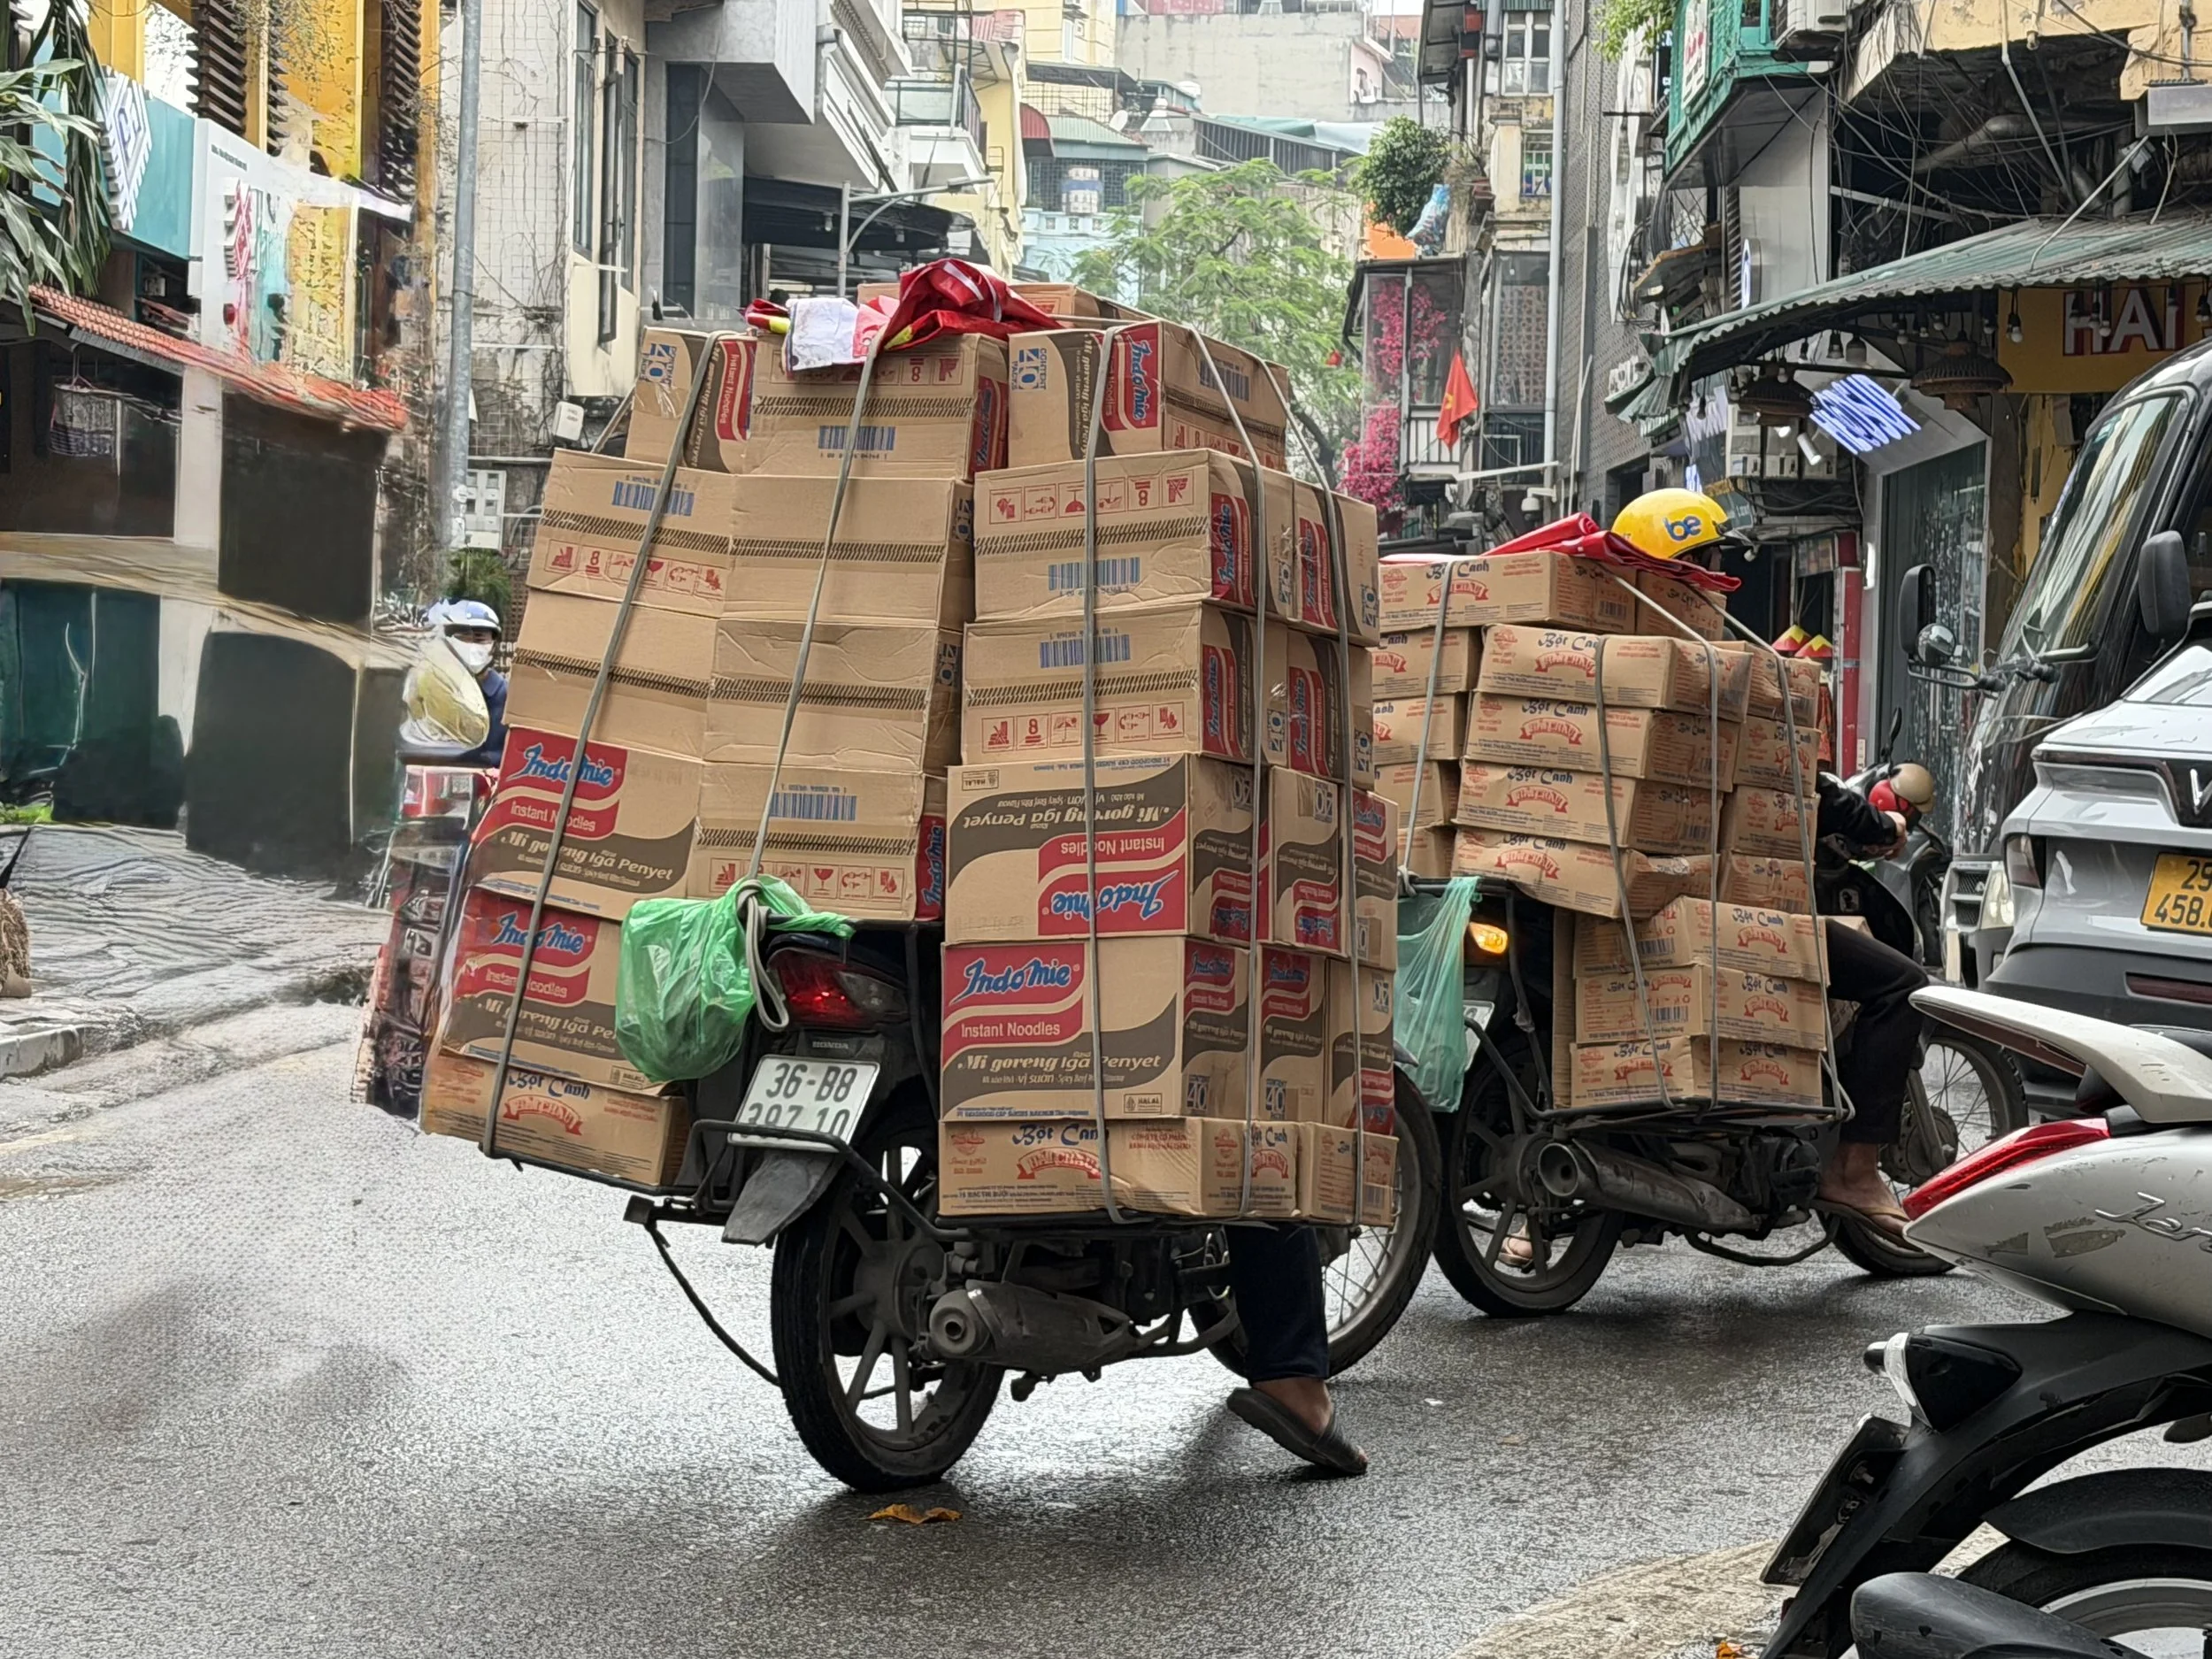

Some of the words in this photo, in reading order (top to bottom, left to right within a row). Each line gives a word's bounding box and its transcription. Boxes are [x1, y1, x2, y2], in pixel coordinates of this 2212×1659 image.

[1663, 514, 1701, 542] be
[1458, 559, 1489, 577] Canh
[1571, 635, 1598, 650] Can
[1373, 703, 1394, 714] anh
[511, 800, 548, 823] Instant
[552, 811, 596, 833] Nodles
[964, 812, 1027, 828] Penyet
[1064, 804, 1131, 823] gorng
[1061, 841, 1117, 856] Nodles
[1120, 837, 1165, 853] Instant
[529, 840, 588, 863] goeng
[619, 857, 673, 881] Penyet
[2181, 860, 2212, 892] 29
[2154, 893, 2212, 929] 458.
[486, 969, 518, 986] Instan
[527, 978, 568, 999] oodles
[961, 1022, 1003, 1038] Instant
[1007, 1021, 1061, 1037] Noodles
[812, 1041, 849, 1049] HONDA
[990, 1056, 1058, 1072] goreng
[766, 1063, 857, 1102] 36-B8
[1012, 1124, 1055, 1146] Bột
